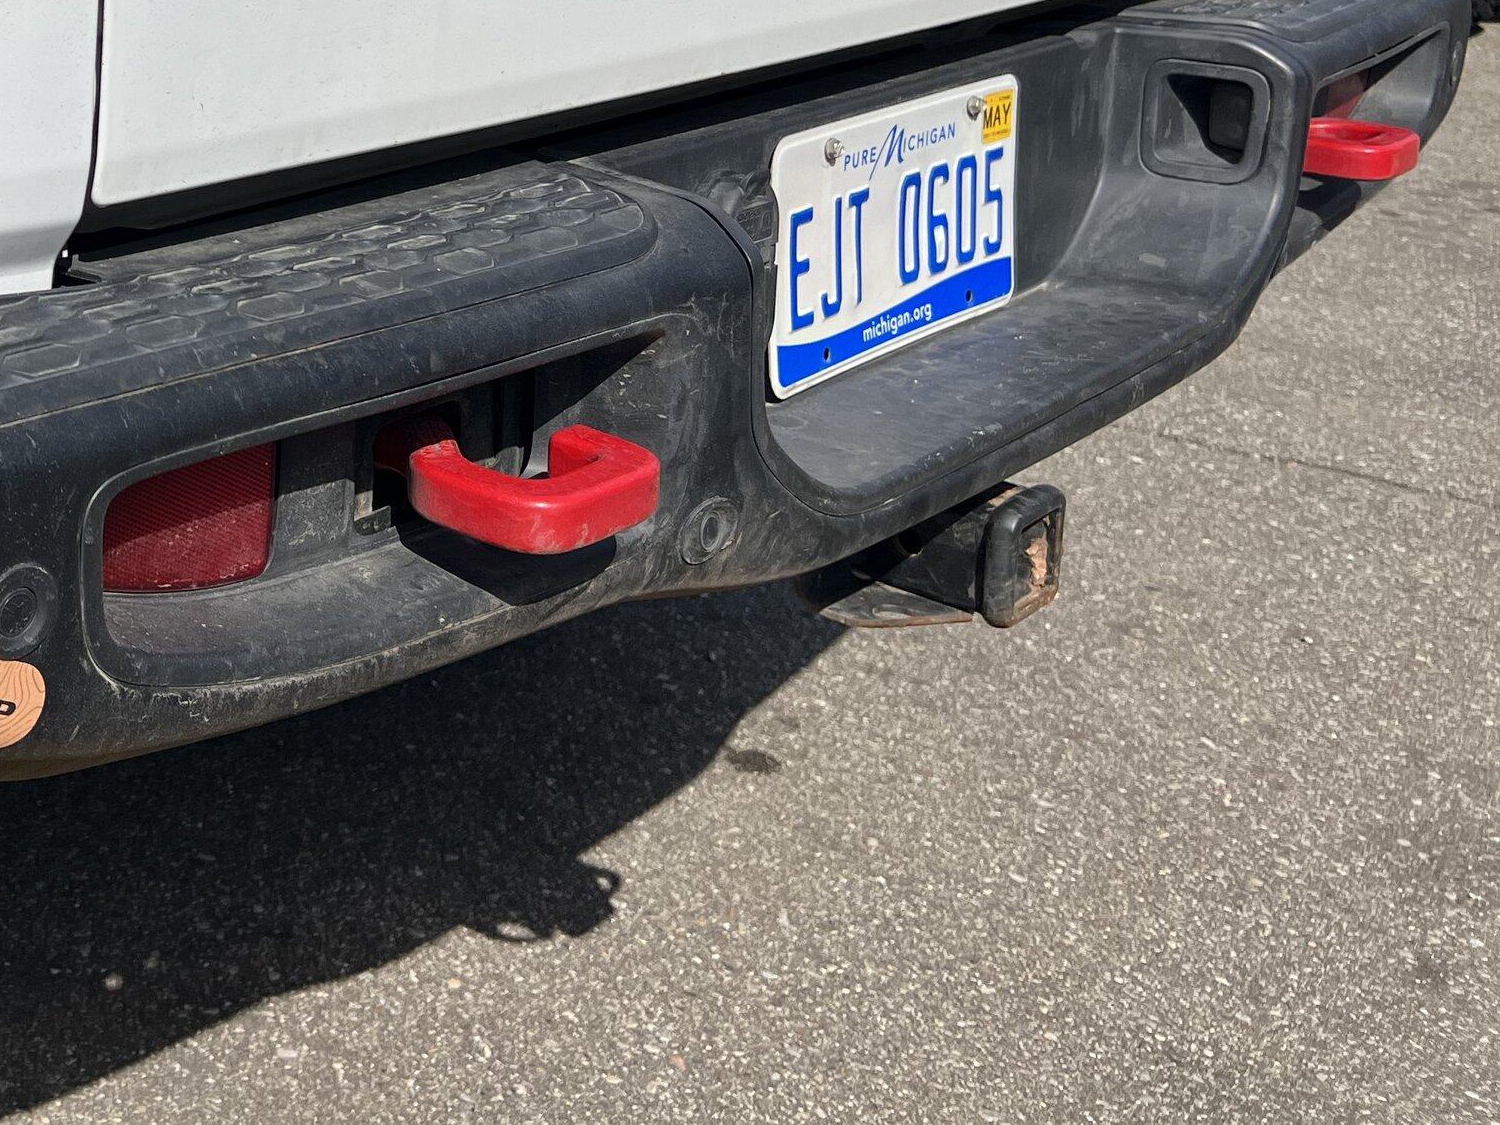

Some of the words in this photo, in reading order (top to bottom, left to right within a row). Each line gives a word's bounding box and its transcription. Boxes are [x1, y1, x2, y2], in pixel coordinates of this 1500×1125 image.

[982, 102, 1012, 130] MAY
[844, 147, 877, 172] PURE
[869, 124, 956, 181] MICHIGAN
[790, 187, 870, 331] EJT
[899, 146, 1004, 286] 0605
[862, 302, 932, 342] michigan.org
